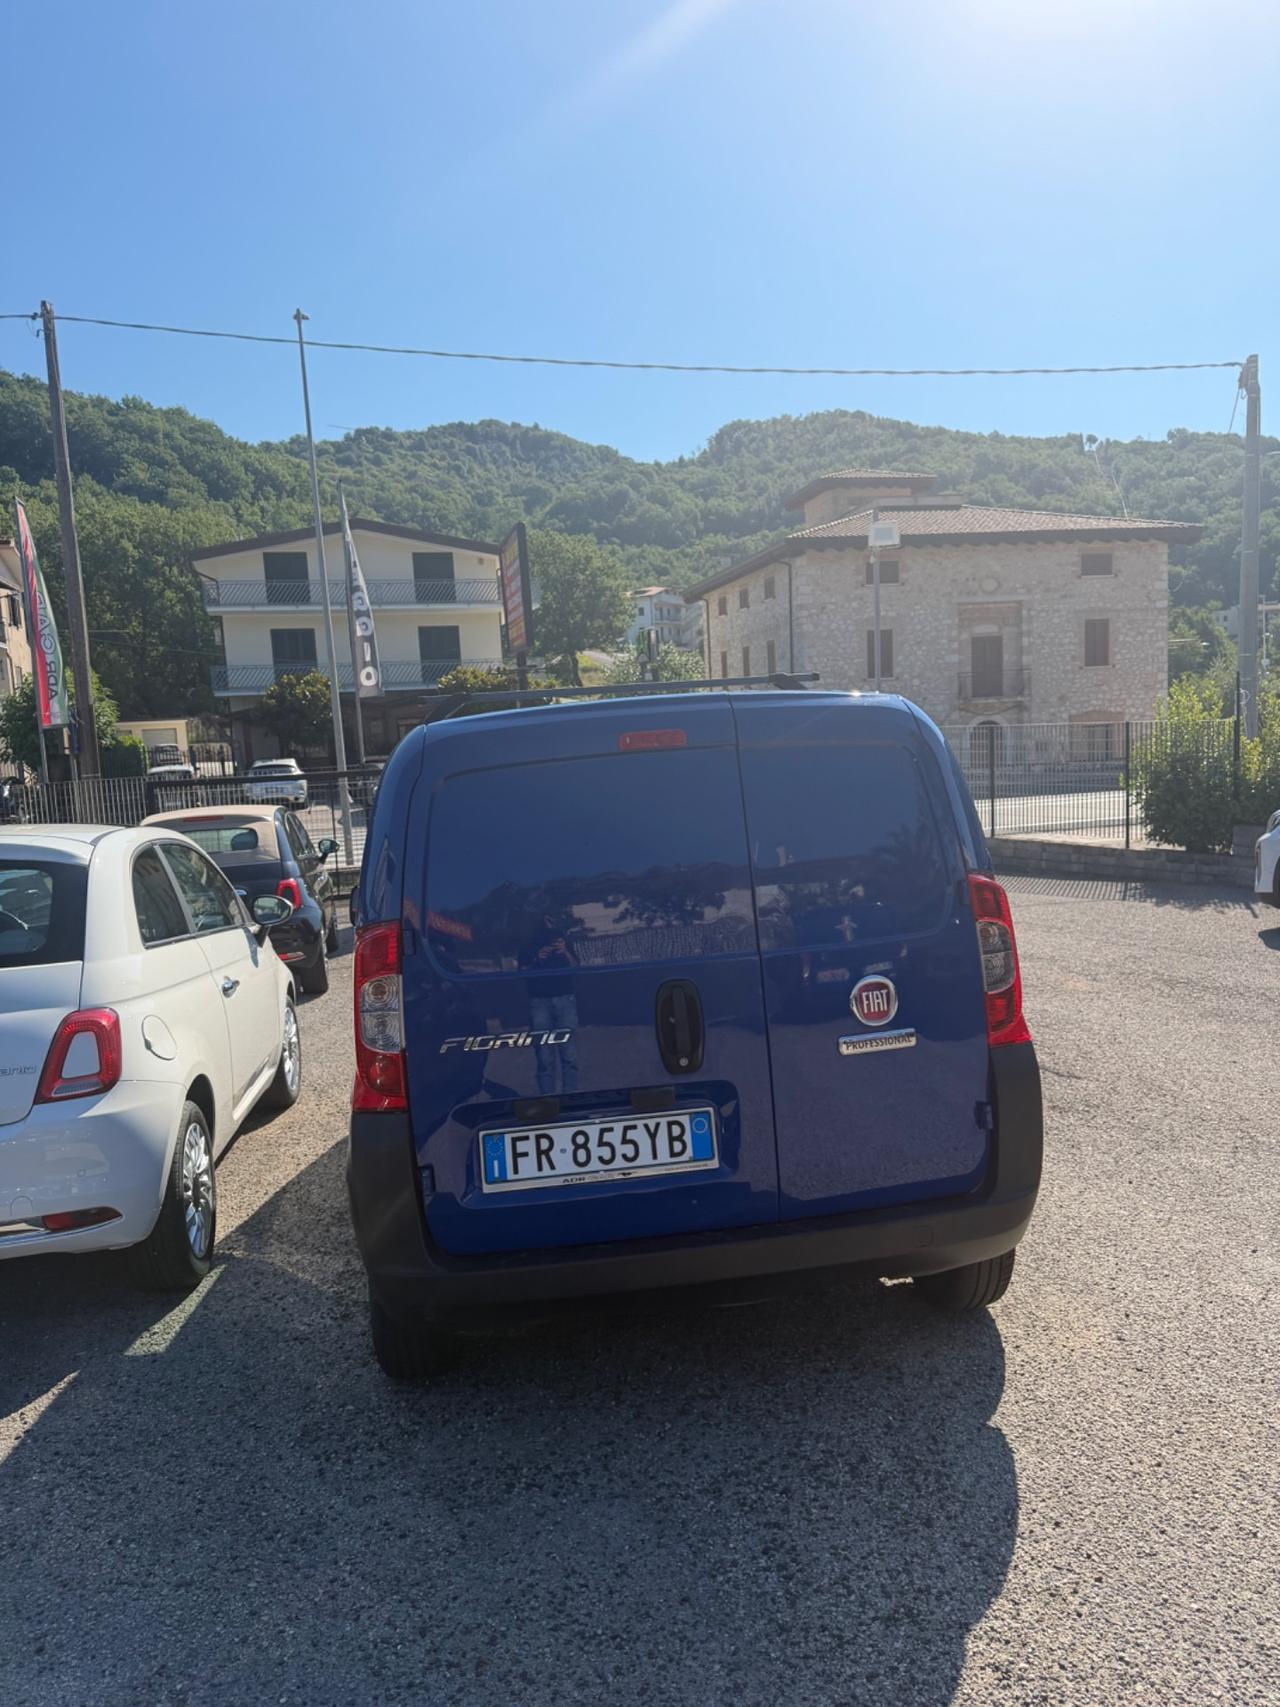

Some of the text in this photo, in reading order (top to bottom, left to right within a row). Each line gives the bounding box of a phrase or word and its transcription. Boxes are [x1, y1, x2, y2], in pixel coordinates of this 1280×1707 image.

[862, 989, 889, 1013] FIAT
[844, 1033, 914, 1050] PROFESSIONAL
[511, 1133, 556, 1175] FR
[571, 1120, 688, 1168] 855YB
